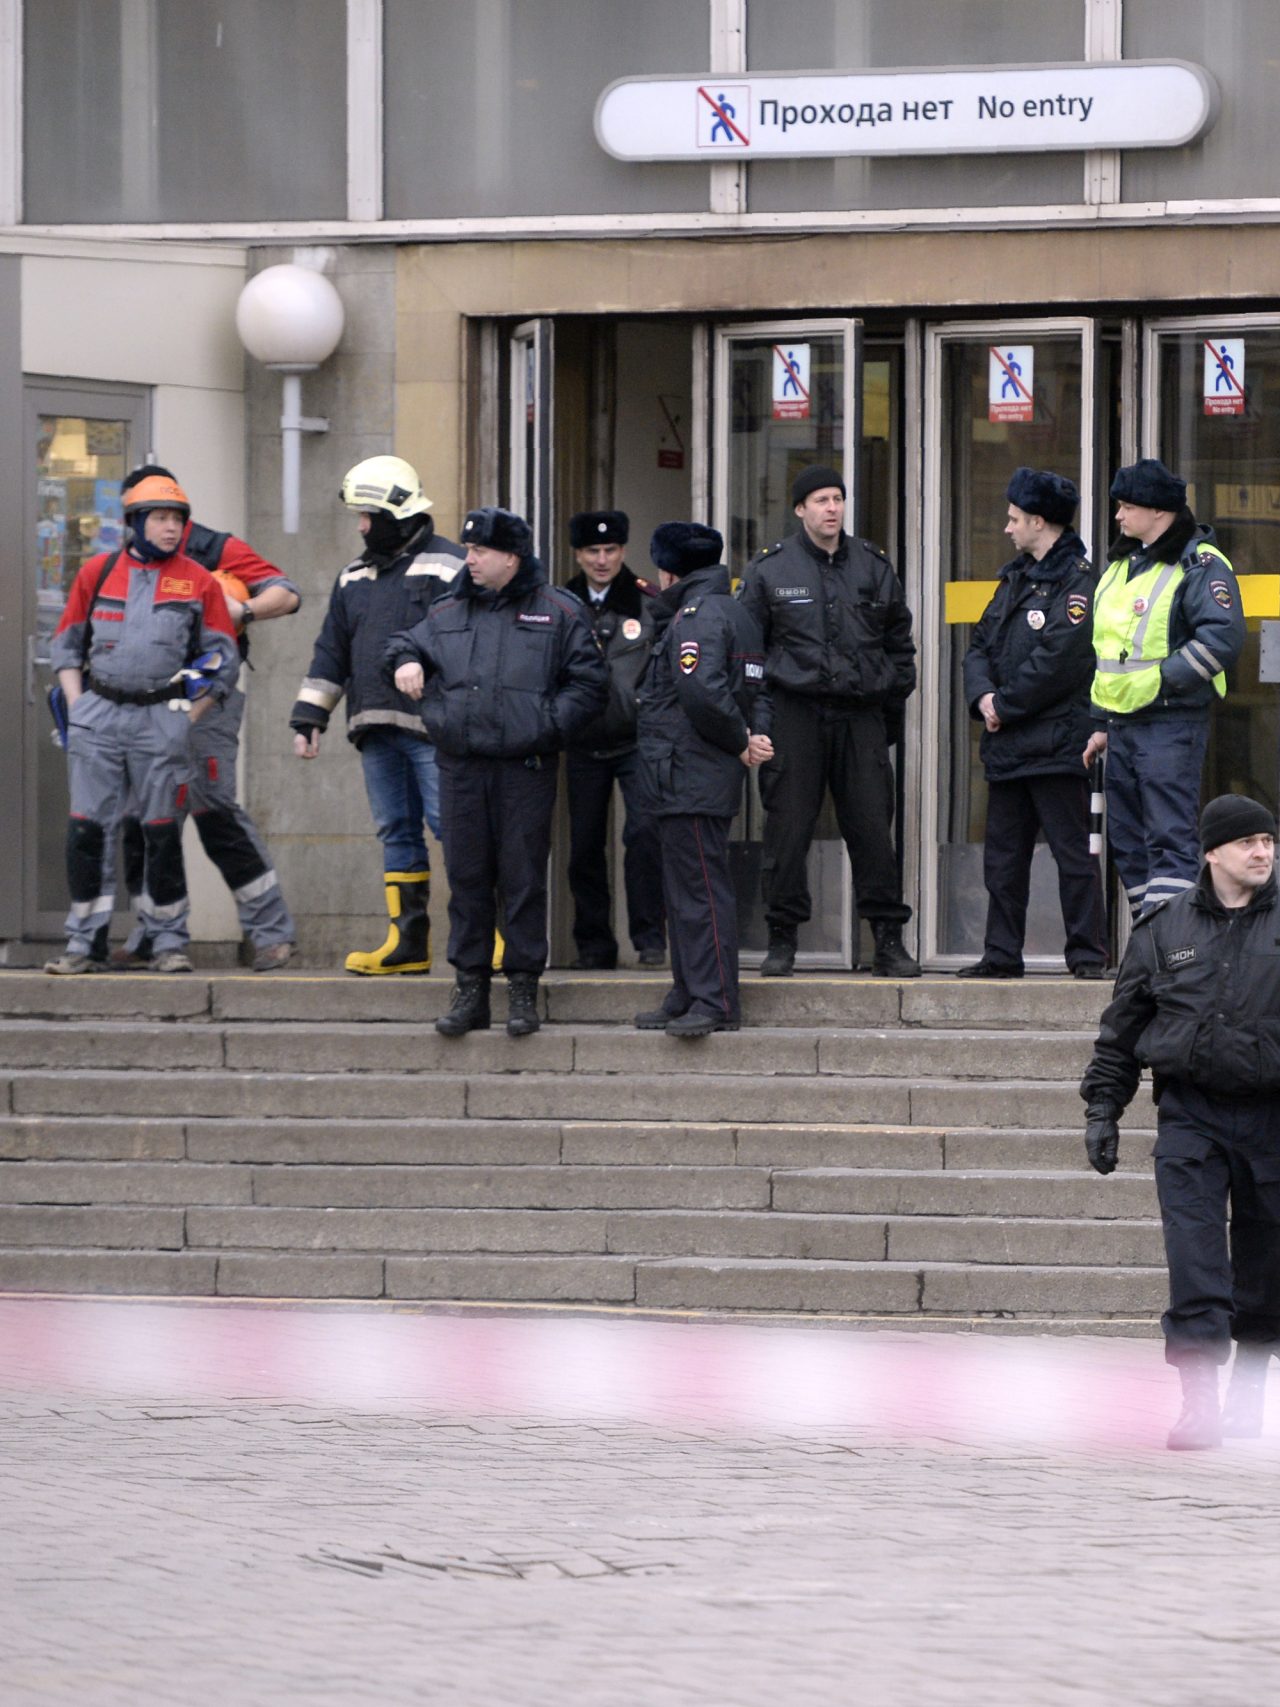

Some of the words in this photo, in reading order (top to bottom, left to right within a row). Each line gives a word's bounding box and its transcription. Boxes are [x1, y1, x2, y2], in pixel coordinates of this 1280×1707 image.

[759, 99, 893, 132] Прохода
[903, 99, 954, 121] нет
[978, 95, 1015, 119] No
[1023, 93, 1094, 122] entry
[1205, 397, 1231, 407] Прохода
[990, 404, 1020, 413] Прохода
[1221, 406, 1236, 415] entry
[1008, 413, 1024, 421] entry
